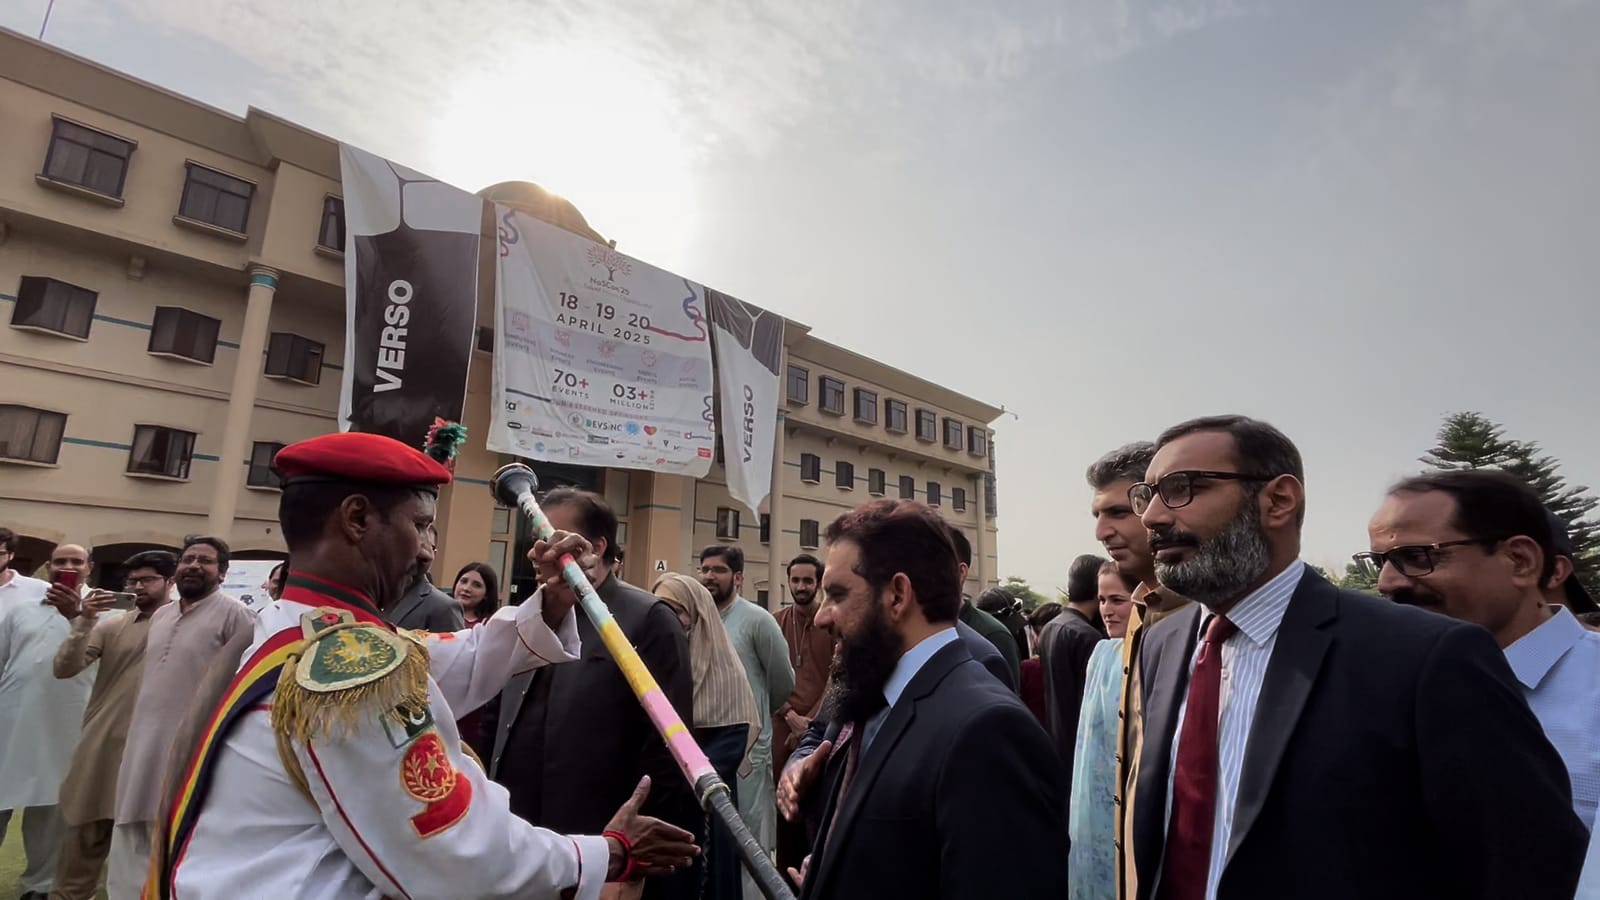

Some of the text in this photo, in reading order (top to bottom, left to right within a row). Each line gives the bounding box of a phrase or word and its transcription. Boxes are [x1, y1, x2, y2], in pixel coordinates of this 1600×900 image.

[560, 292, 578, 310] 18
[596, 303, 615, 320] 19
[628, 313, 650, 330] 20
[373, 280, 413, 392] VERSO
[556, 313, 651, 345] APRIL 2025
[554, 368, 589, 389] 70+
[552, 385, 589, 399] EVENTS
[613, 384, 648, 400] 03+
[610, 398, 649, 410] MILLION
[744, 384, 754, 463] VERSO
[657, 560, 665, 570] A
